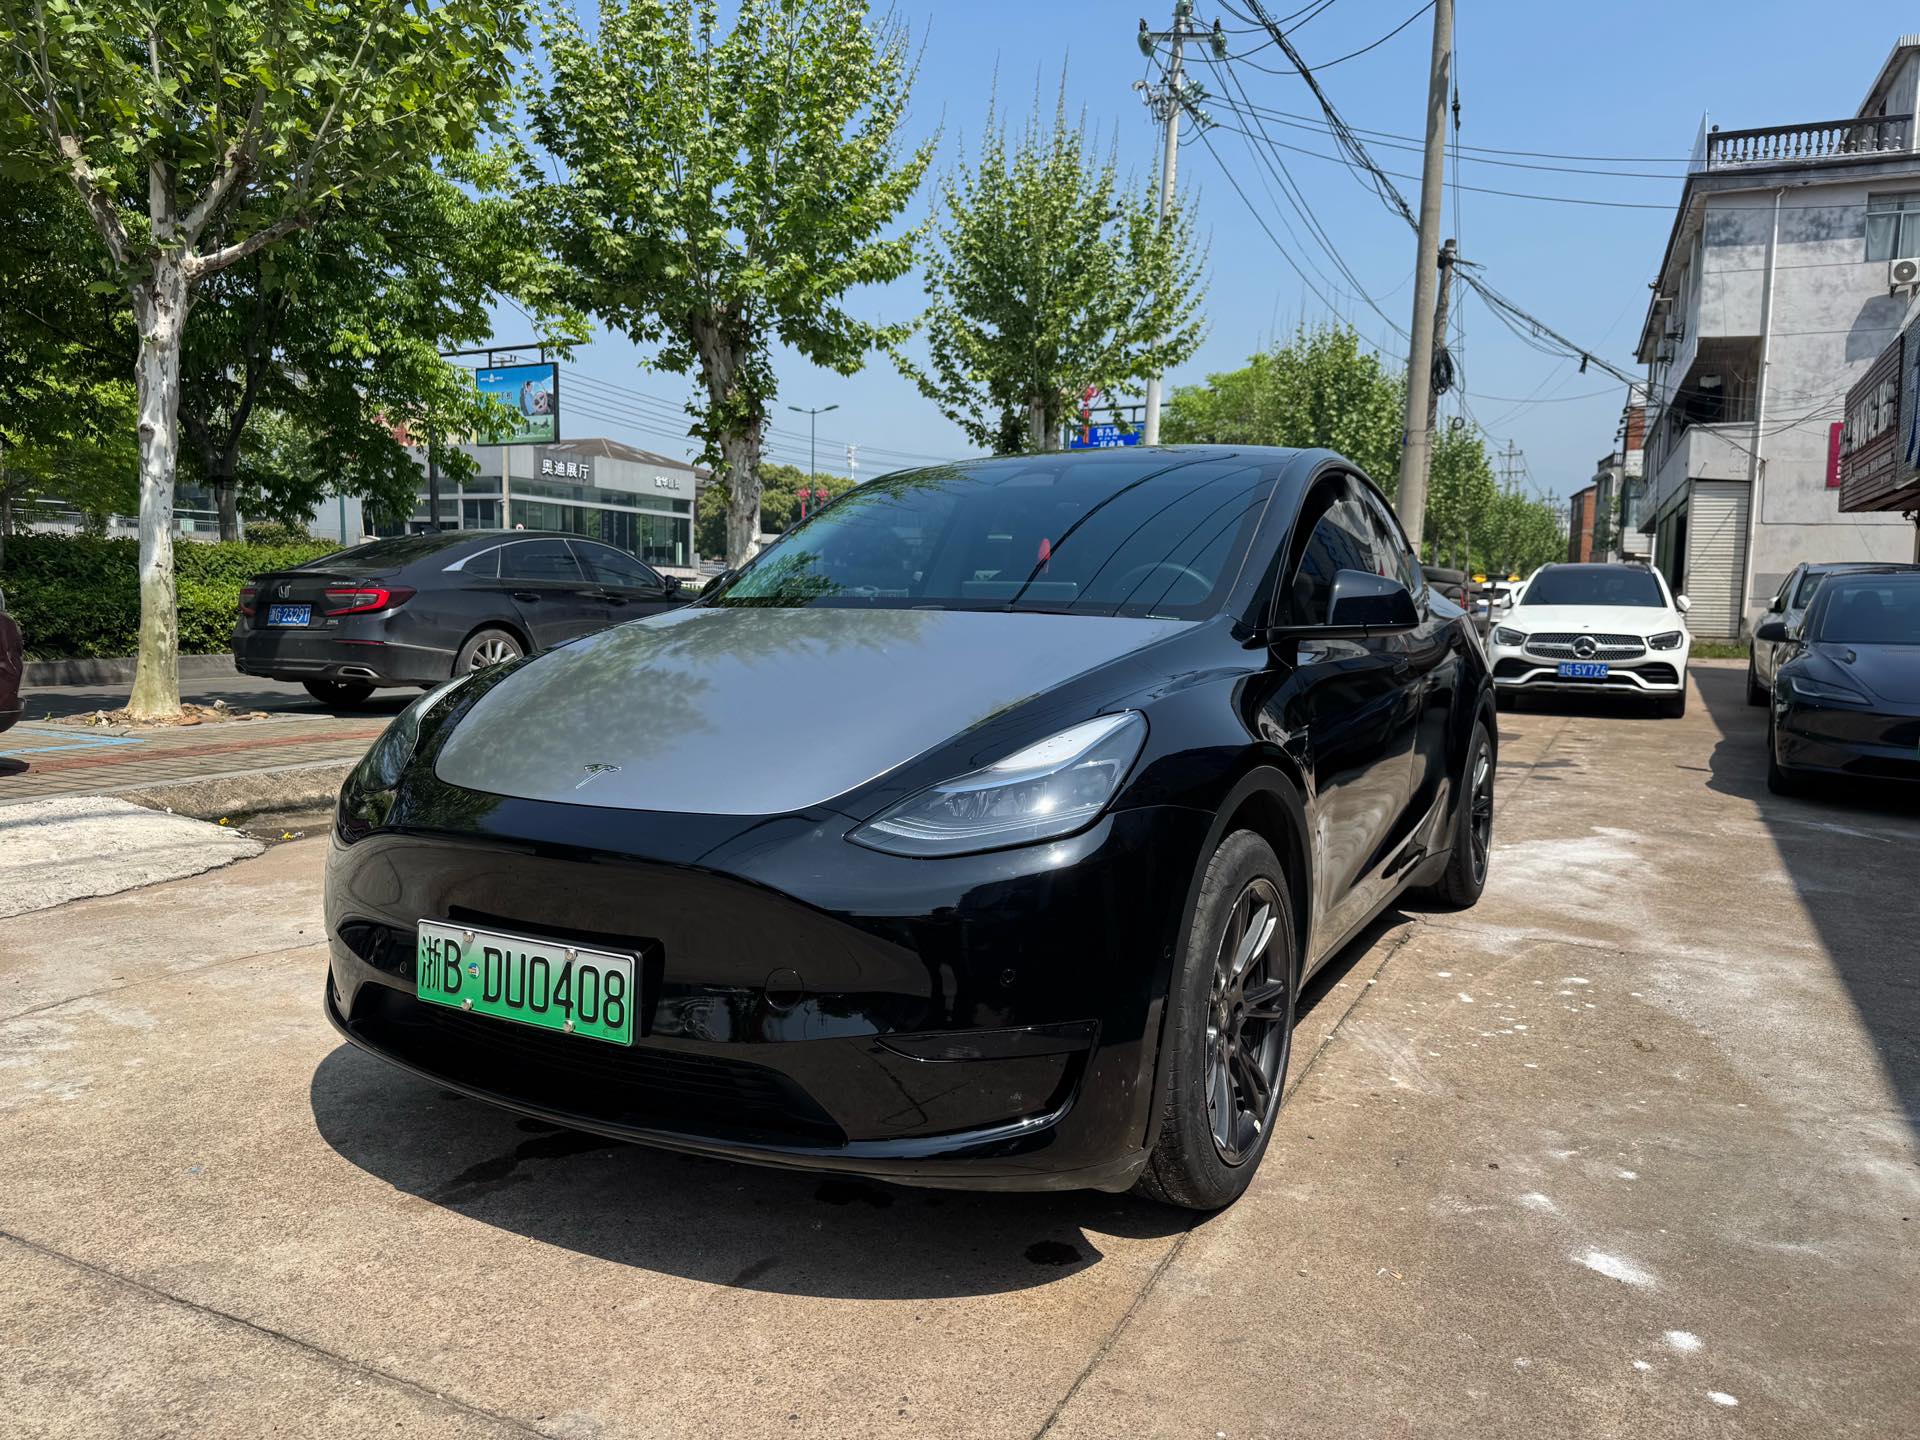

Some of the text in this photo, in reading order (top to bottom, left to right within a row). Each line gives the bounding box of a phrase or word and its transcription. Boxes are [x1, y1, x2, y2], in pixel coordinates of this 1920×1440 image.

[541, 459, 590, 480] 奥迪展厅
[482, 946, 626, 1029] DU0408
